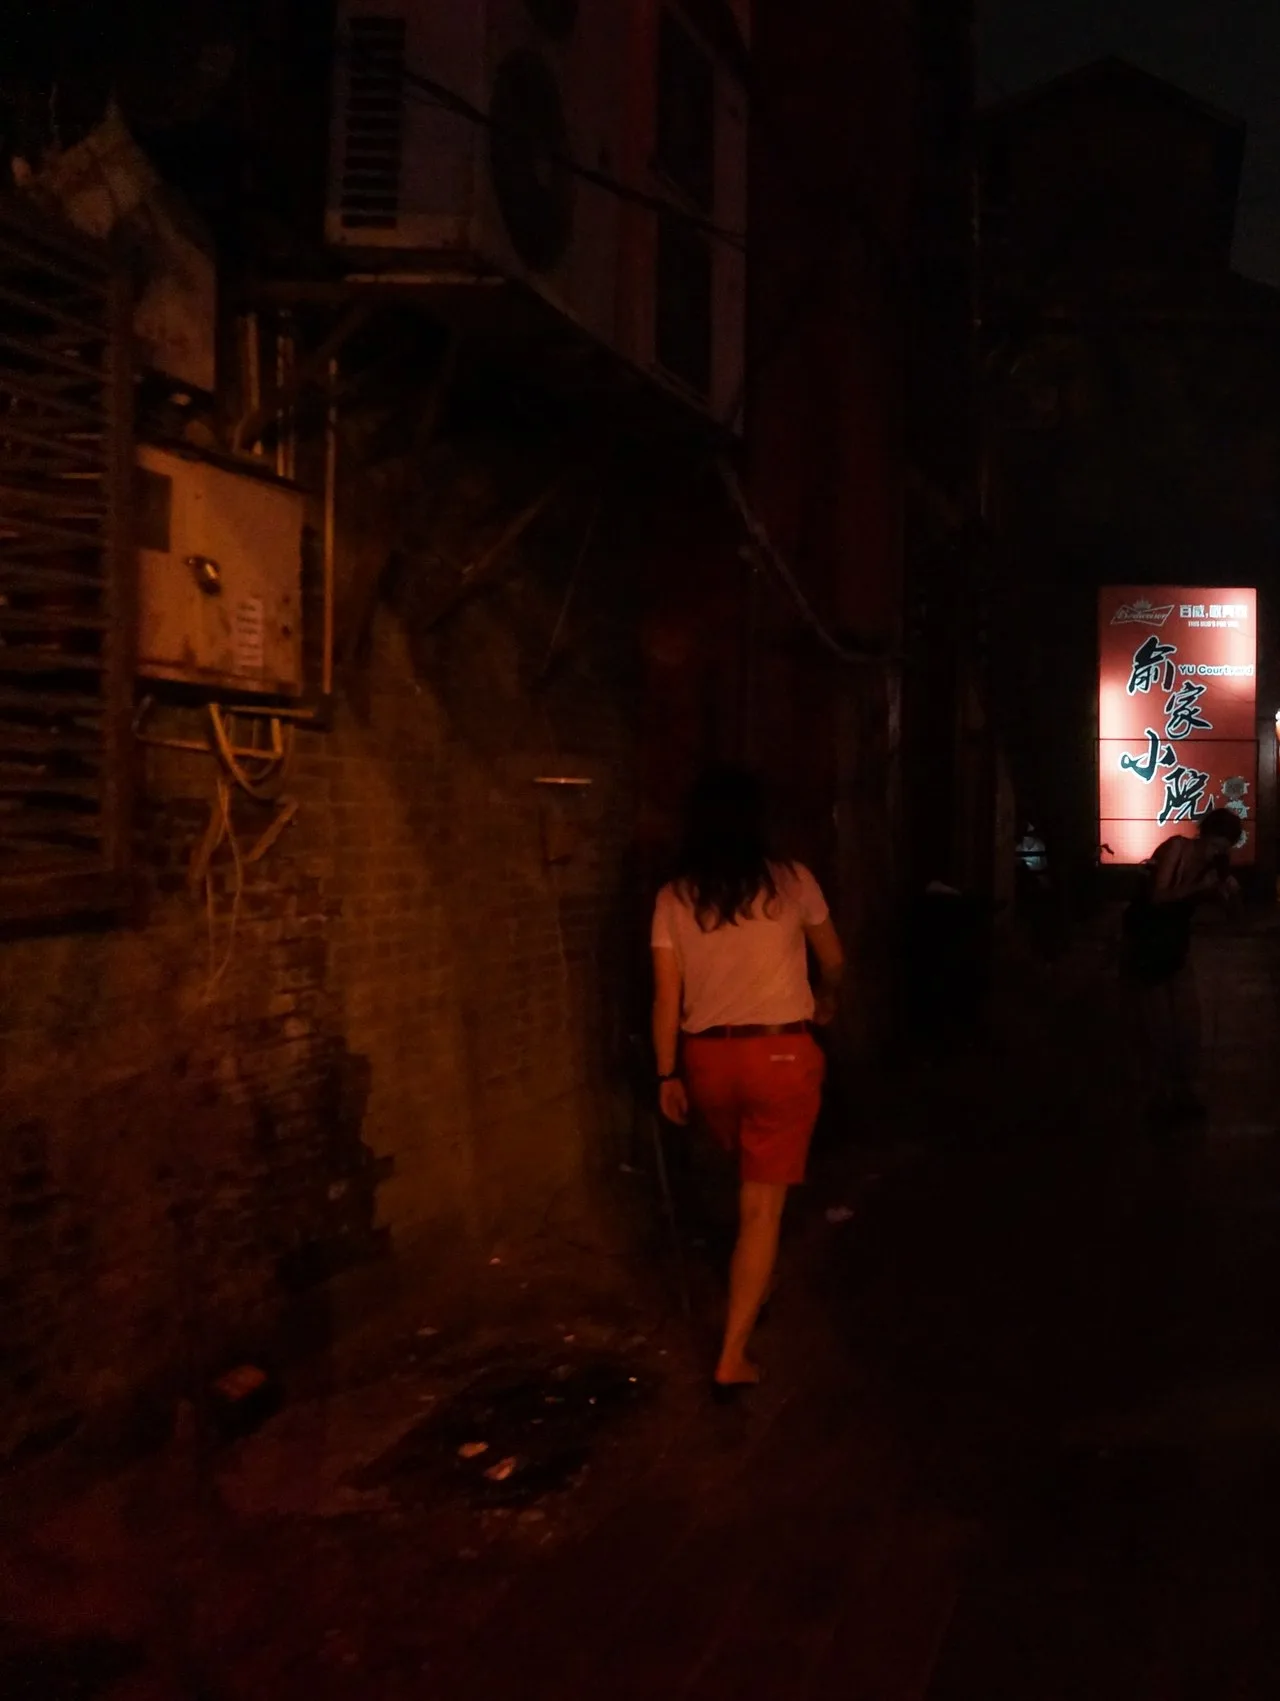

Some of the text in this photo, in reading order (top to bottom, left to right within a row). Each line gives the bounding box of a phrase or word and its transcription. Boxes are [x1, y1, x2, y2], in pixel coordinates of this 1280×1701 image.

[1179, 664, 1196, 675] YU
[1121, 635, 1215, 825] 俞家小院
